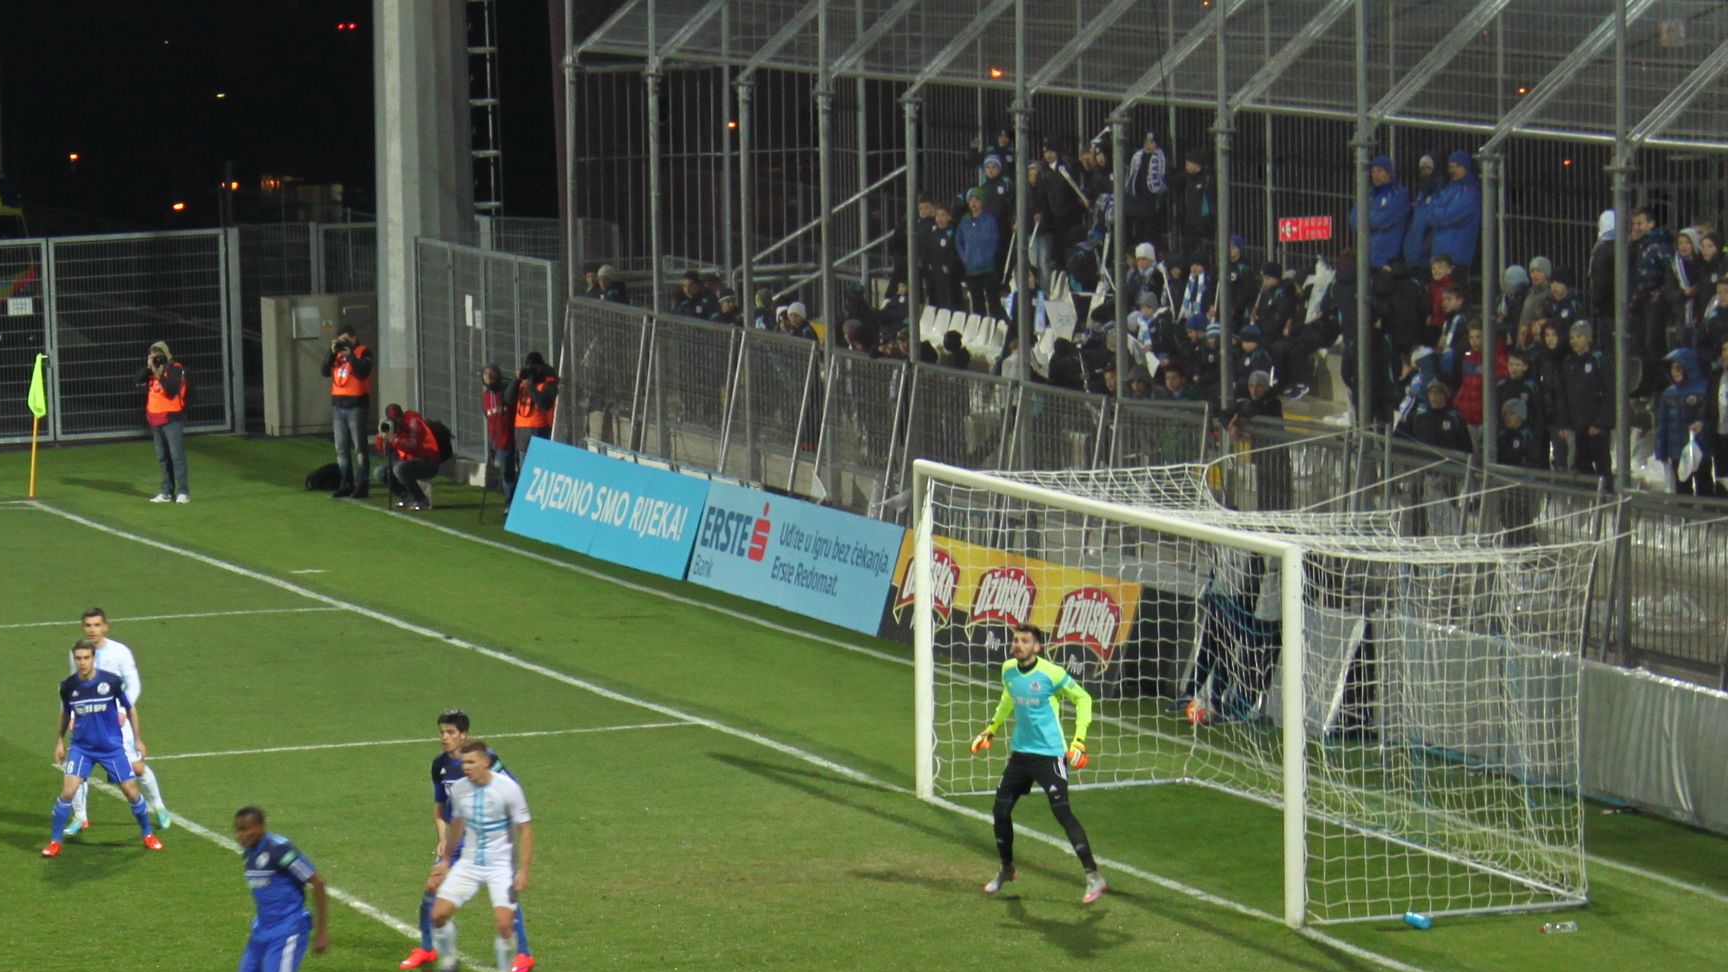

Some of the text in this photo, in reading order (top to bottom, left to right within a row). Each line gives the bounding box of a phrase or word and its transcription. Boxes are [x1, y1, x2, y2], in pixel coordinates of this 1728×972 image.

[525, 467, 688, 542] ZAJEDNO SMO RIJEKA!
[700, 506, 753, 557] ERSTE
[804, 534, 813, 552] u
[812, 530, 832, 560] igru
[832, 536, 851, 564] bez
[771, 556, 794, 583] Erste
